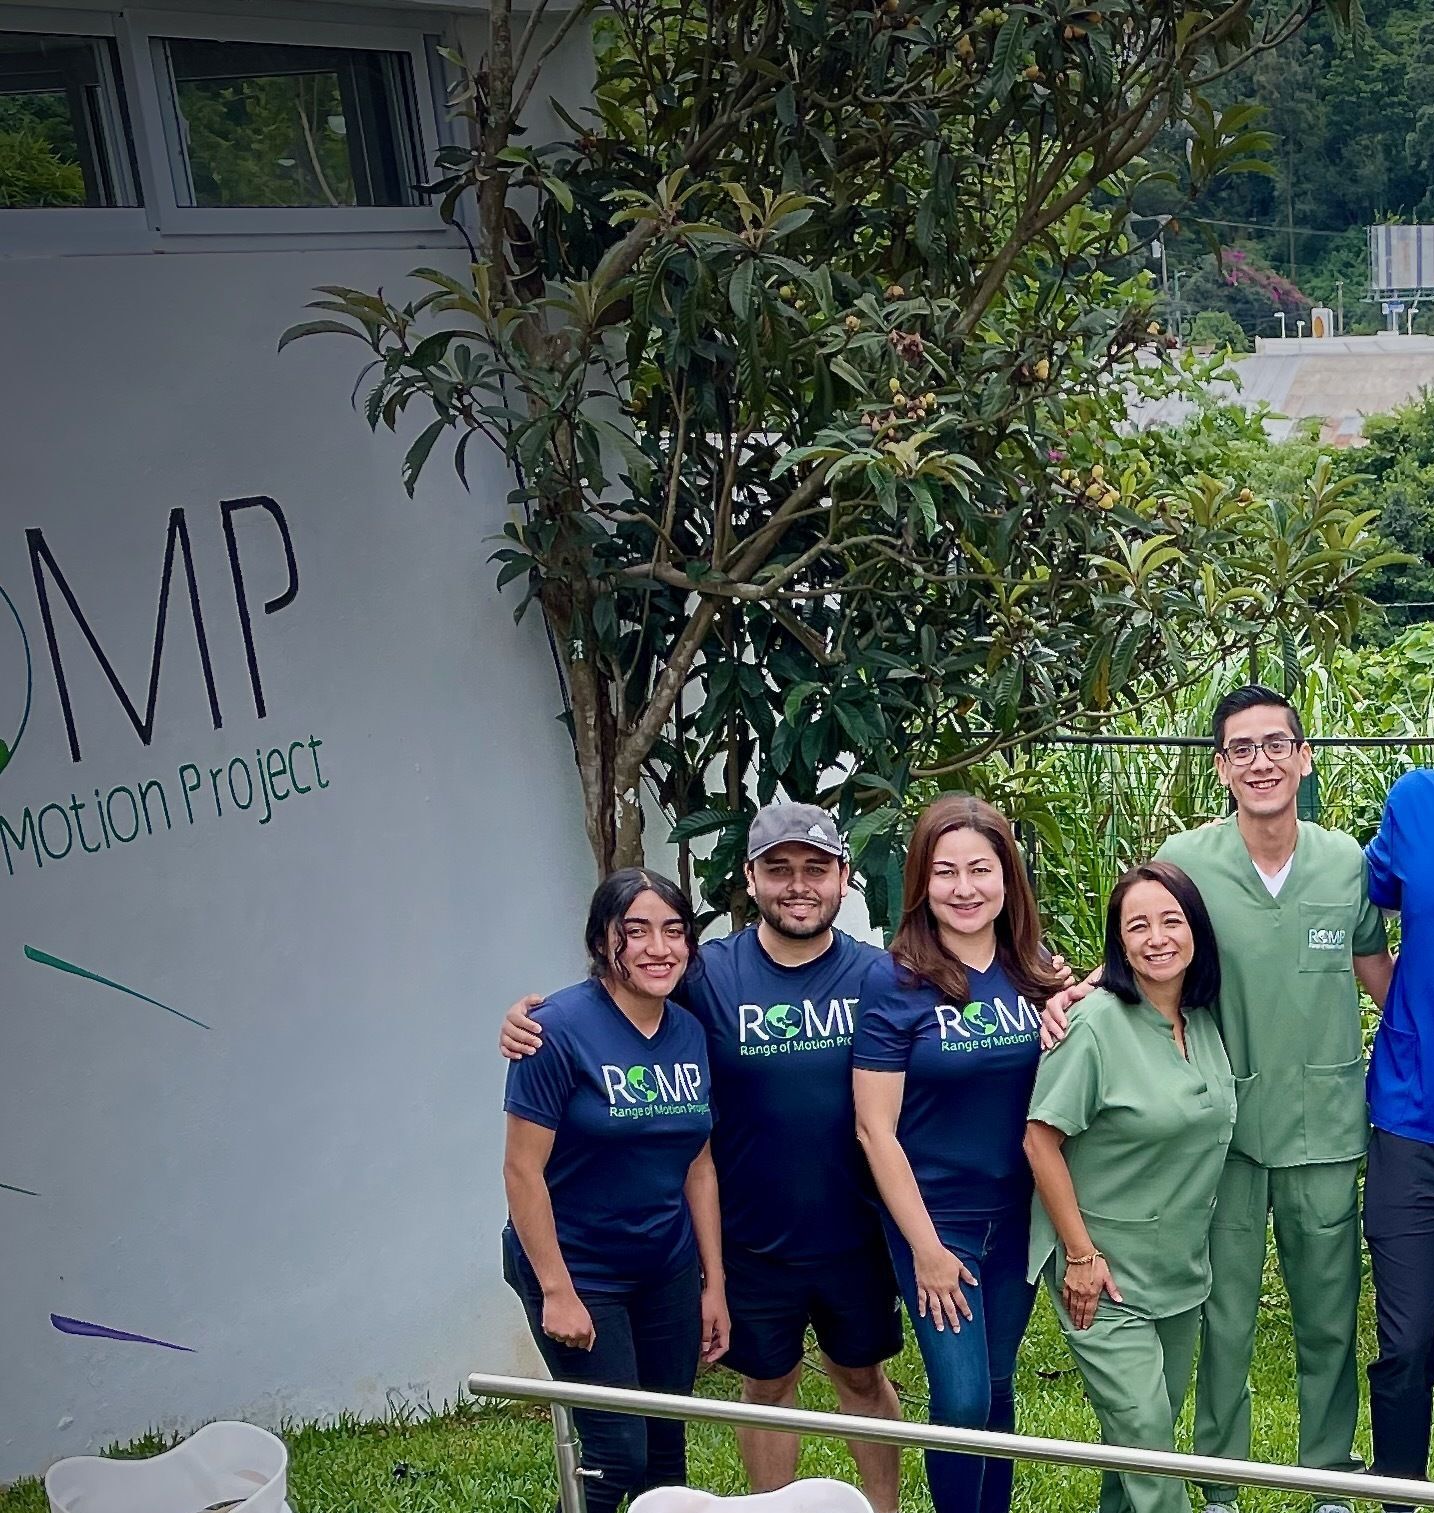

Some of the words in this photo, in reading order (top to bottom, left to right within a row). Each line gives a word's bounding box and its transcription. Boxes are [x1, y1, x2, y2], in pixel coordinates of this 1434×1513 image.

[0, 495, 299, 764] MP
[178, 734, 330, 825] Project
[1308, 929, 1345, 943] ROMP
[740, 1045, 778, 1057] Range
[779, 1041, 790, 1054] of
[793, 1037, 835, 1051] Motion
[941, 1041, 979, 1053] Range
[980, 1037, 991, 1050] of
[994, 1033, 1032, 1047] Motion
[601, 1063, 701, 1105] ROMP
[609, 1105, 644, 1120] Range
[644, 1104, 654, 1118] of
[654, 1104, 687, 1115] Motion
